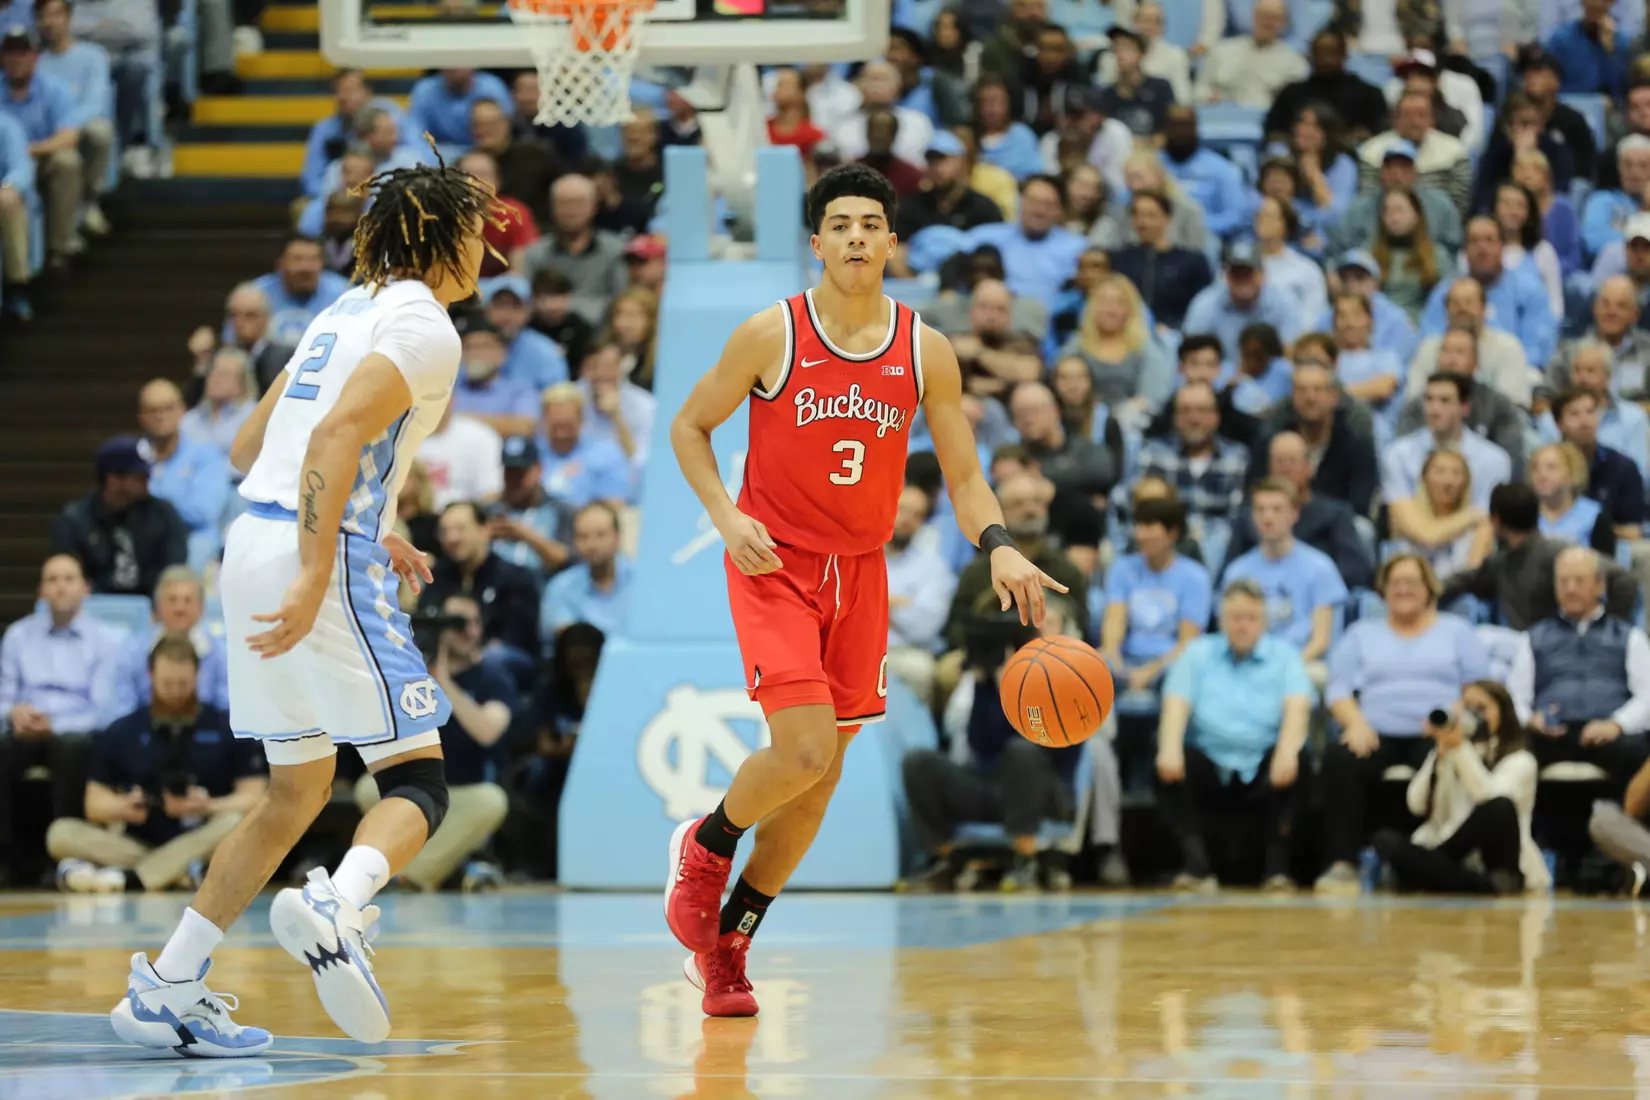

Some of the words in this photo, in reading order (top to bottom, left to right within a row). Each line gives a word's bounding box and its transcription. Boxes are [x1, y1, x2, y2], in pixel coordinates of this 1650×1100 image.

[284, 332, 338, 401] 2
[794, 383, 907, 438] Buckeyes
[829, 439, 866, 486] 3
[302, 470, 325, 535] Crystal
